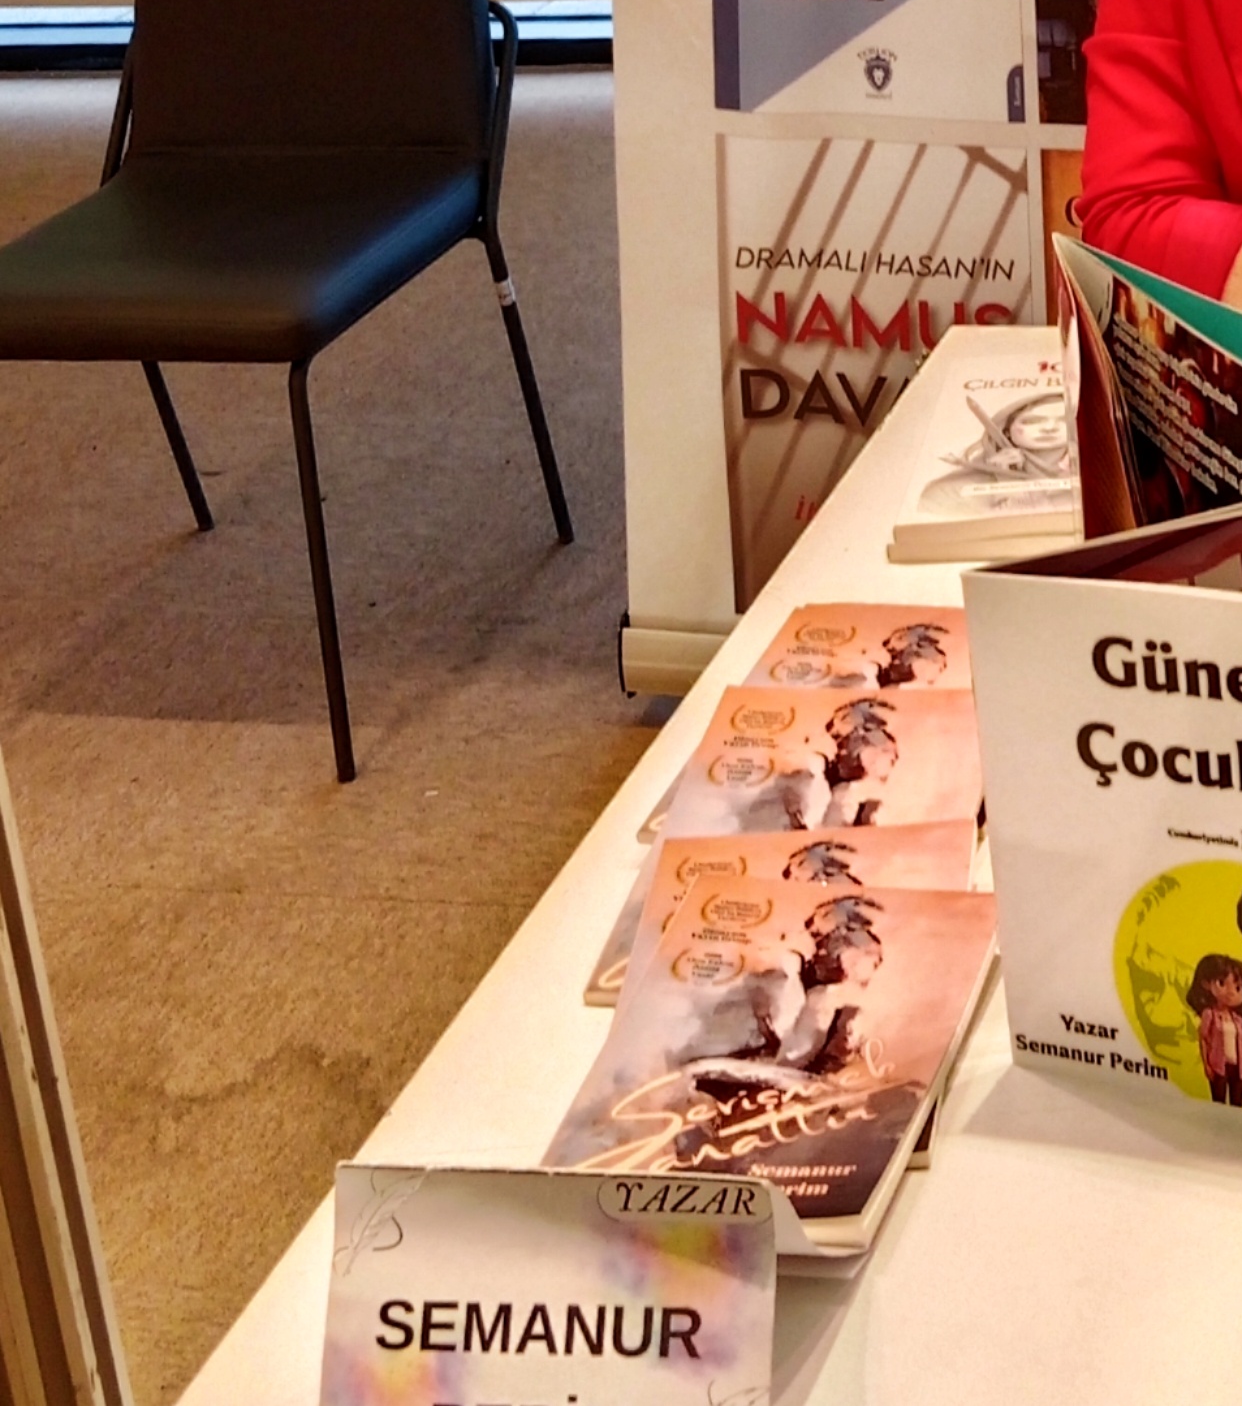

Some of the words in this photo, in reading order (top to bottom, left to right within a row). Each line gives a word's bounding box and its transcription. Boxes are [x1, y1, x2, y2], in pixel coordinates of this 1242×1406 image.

[735, 246, 867, 274] DRAMALI
[875, 255, 1015, 282] HASAN'IN
[739, 368, 912, 427] DAV
[963, 378, 1038, 391] ÇILGIN
[1058, 1013, 1120, 1042] Yazar
[1015, 1033, 1106, 1068] Semanur
[1109, 1050, 1170, 1082] Perim
[749, 1163, 858, 1177] Semanur
[615, 1181, 760, 1217] YAZAR
[375, 1300, 702, 1359] SEMANUR
